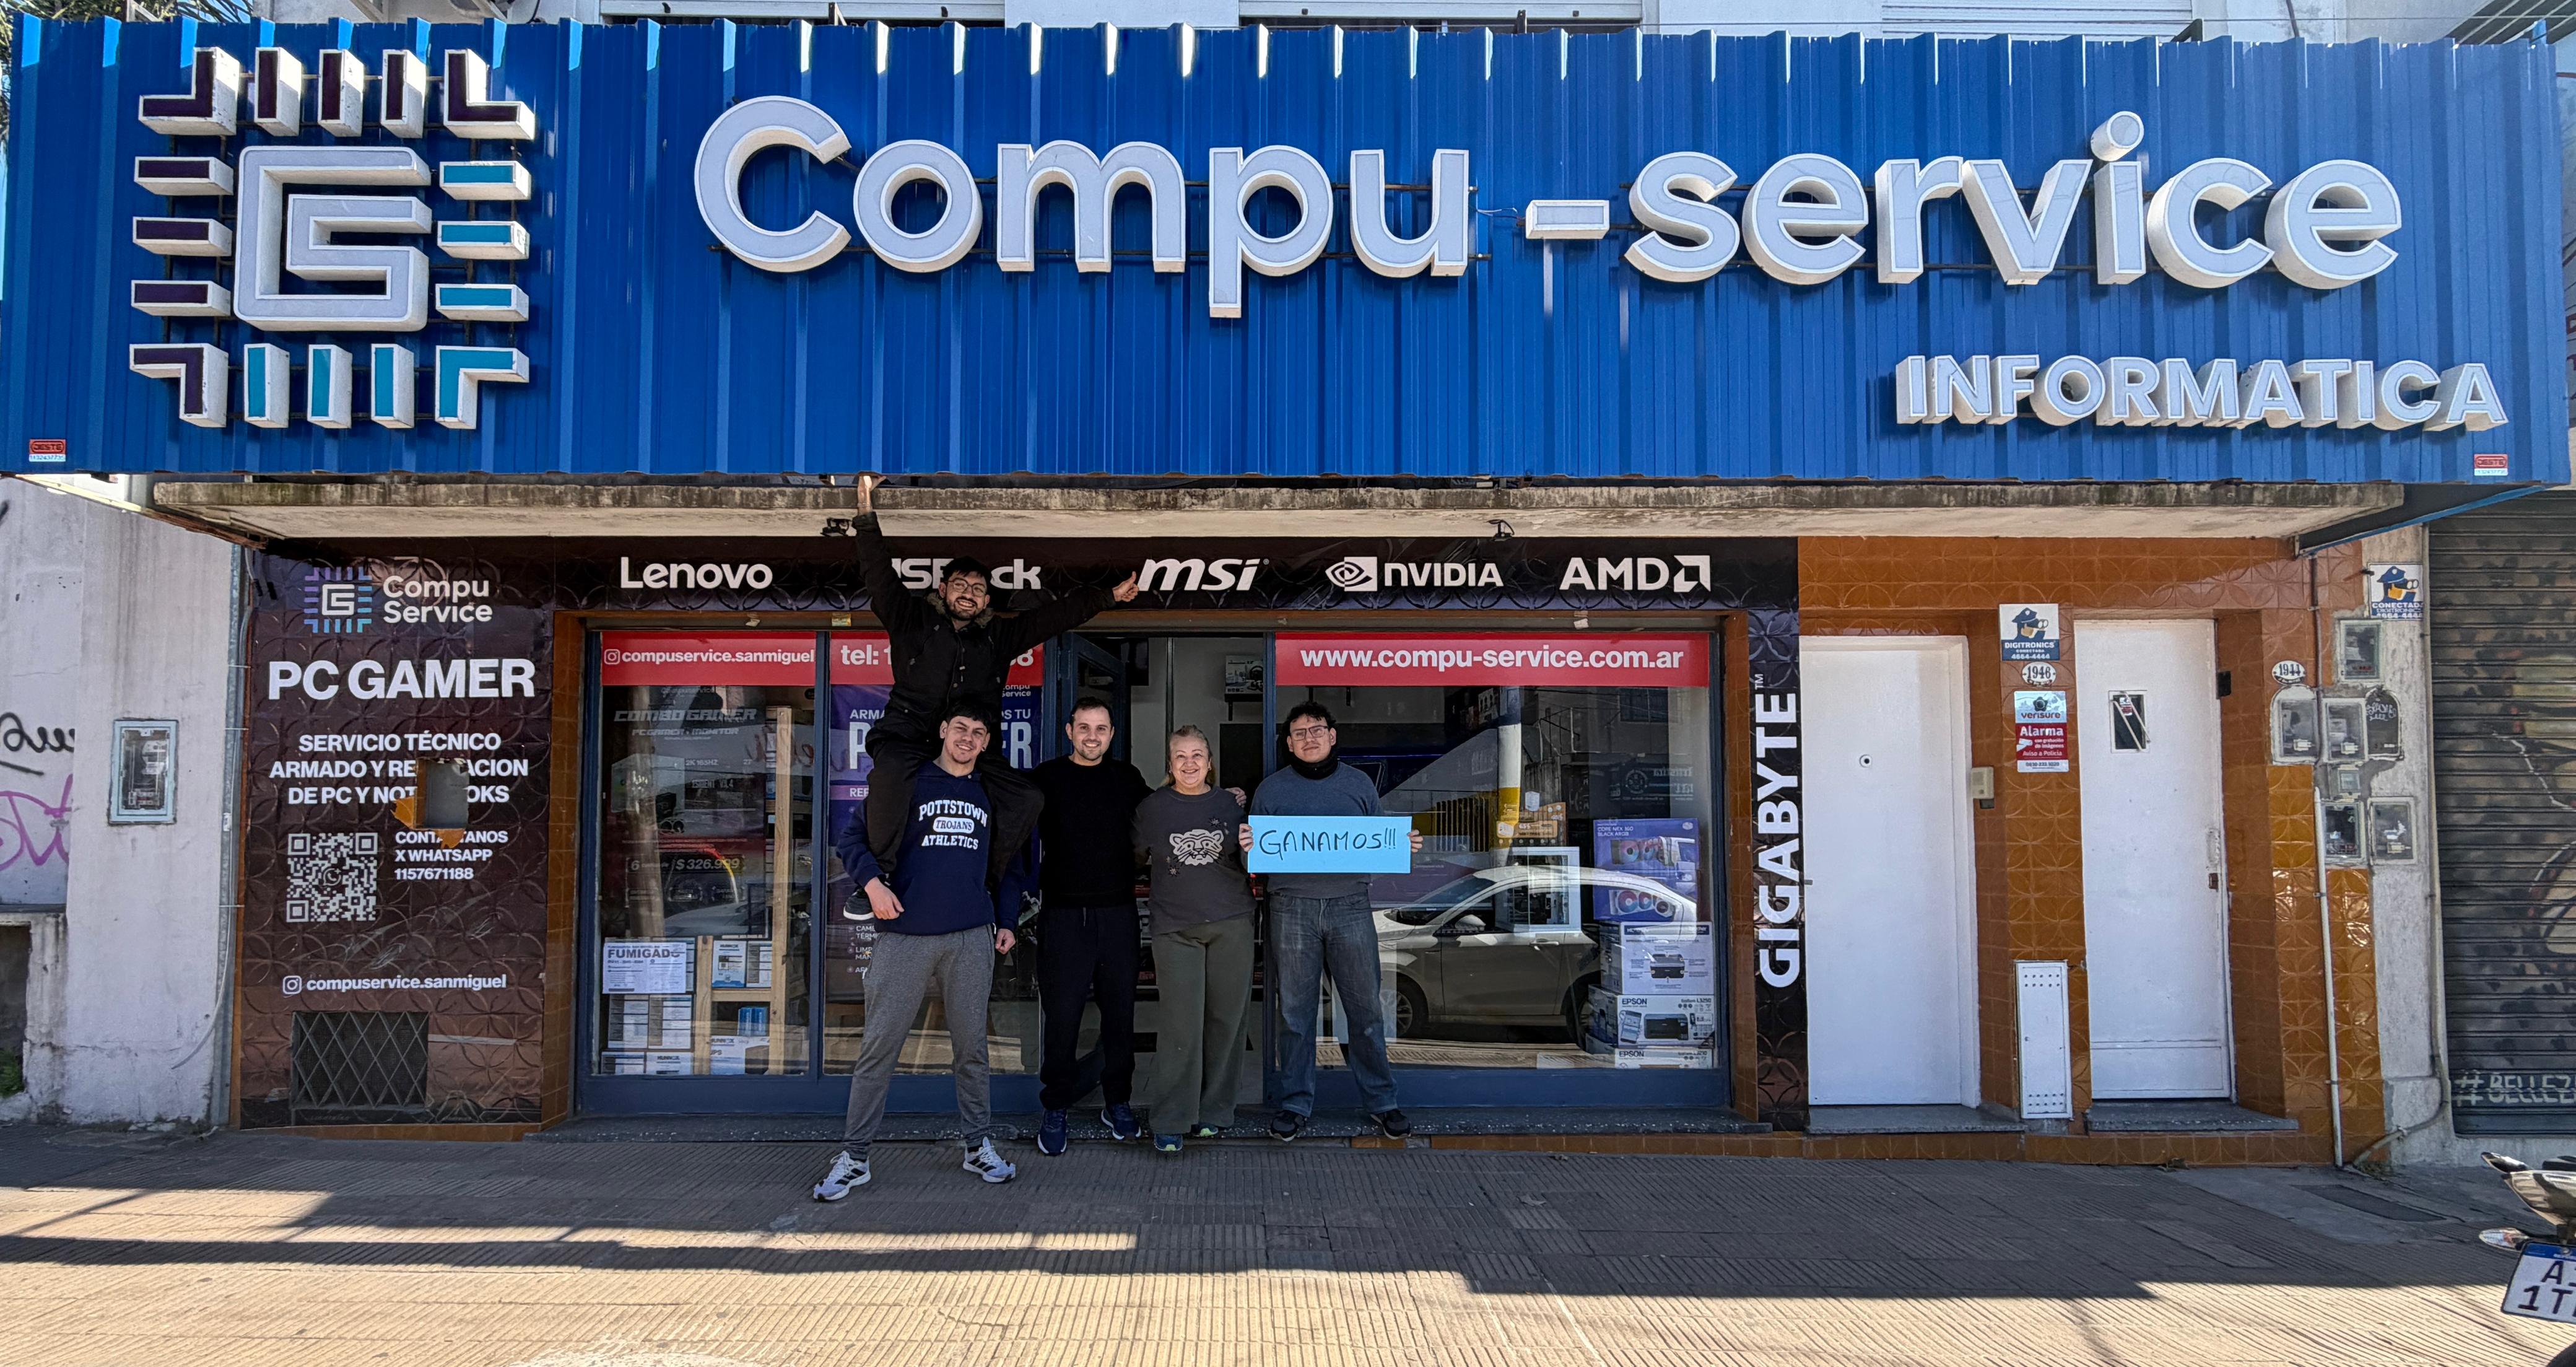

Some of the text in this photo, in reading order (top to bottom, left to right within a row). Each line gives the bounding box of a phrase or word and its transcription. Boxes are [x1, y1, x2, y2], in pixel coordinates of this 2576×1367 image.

[694, 95, 1469, 318] Compu
[1896, 354, 2507, 432] INFORMATICA
[620, 556, 773, 590] Lenovo
[1559, 557, 1669, 591] AMD
[383, 575, 489, 601] Compu
[383, 601, 493, 623] Service
[622, 649, 815, 665] compuservice.sanmiguel
[840, 644, 879, 665] tel:
[1300, 645, 1684, 672] www.compu-service.com.ar
[268, 658, 536, 701] PC GAMER
[2027, 665, 2052, 679] 1946
[2278, 663, 2301, 676] 1944
[614, 709, 685, 722] COMBO
[1014, 709, 1032, 720] TU
[298, 730, 502, 752] SERVICIO TÉCNICO
[2020, 725, 2064, 736] Alarma
[269, 760, 367, 778] ARMADO
[370, 760, 388, 778] Y
[289, 785, 510, 804] DE PC Y NOTOKS
[919, 799, 988, 827] POTTSTOWN
[936, 820, 973, 831] TROJANS
[921, 834, 979, 850] ATHLETICS
[1260, 827, 1397, 860] GANAMOS!!!
[1754, 692, 1801, 988] GIGABYTE
[395, 849, 493, 862] X WHATSAPP
[394, 868, 474, 880] 1157671188
[307, 974, 507, 992] compuservice.sanmiguel
[2452, 1070, 2576, 1107] #BELLEZ
